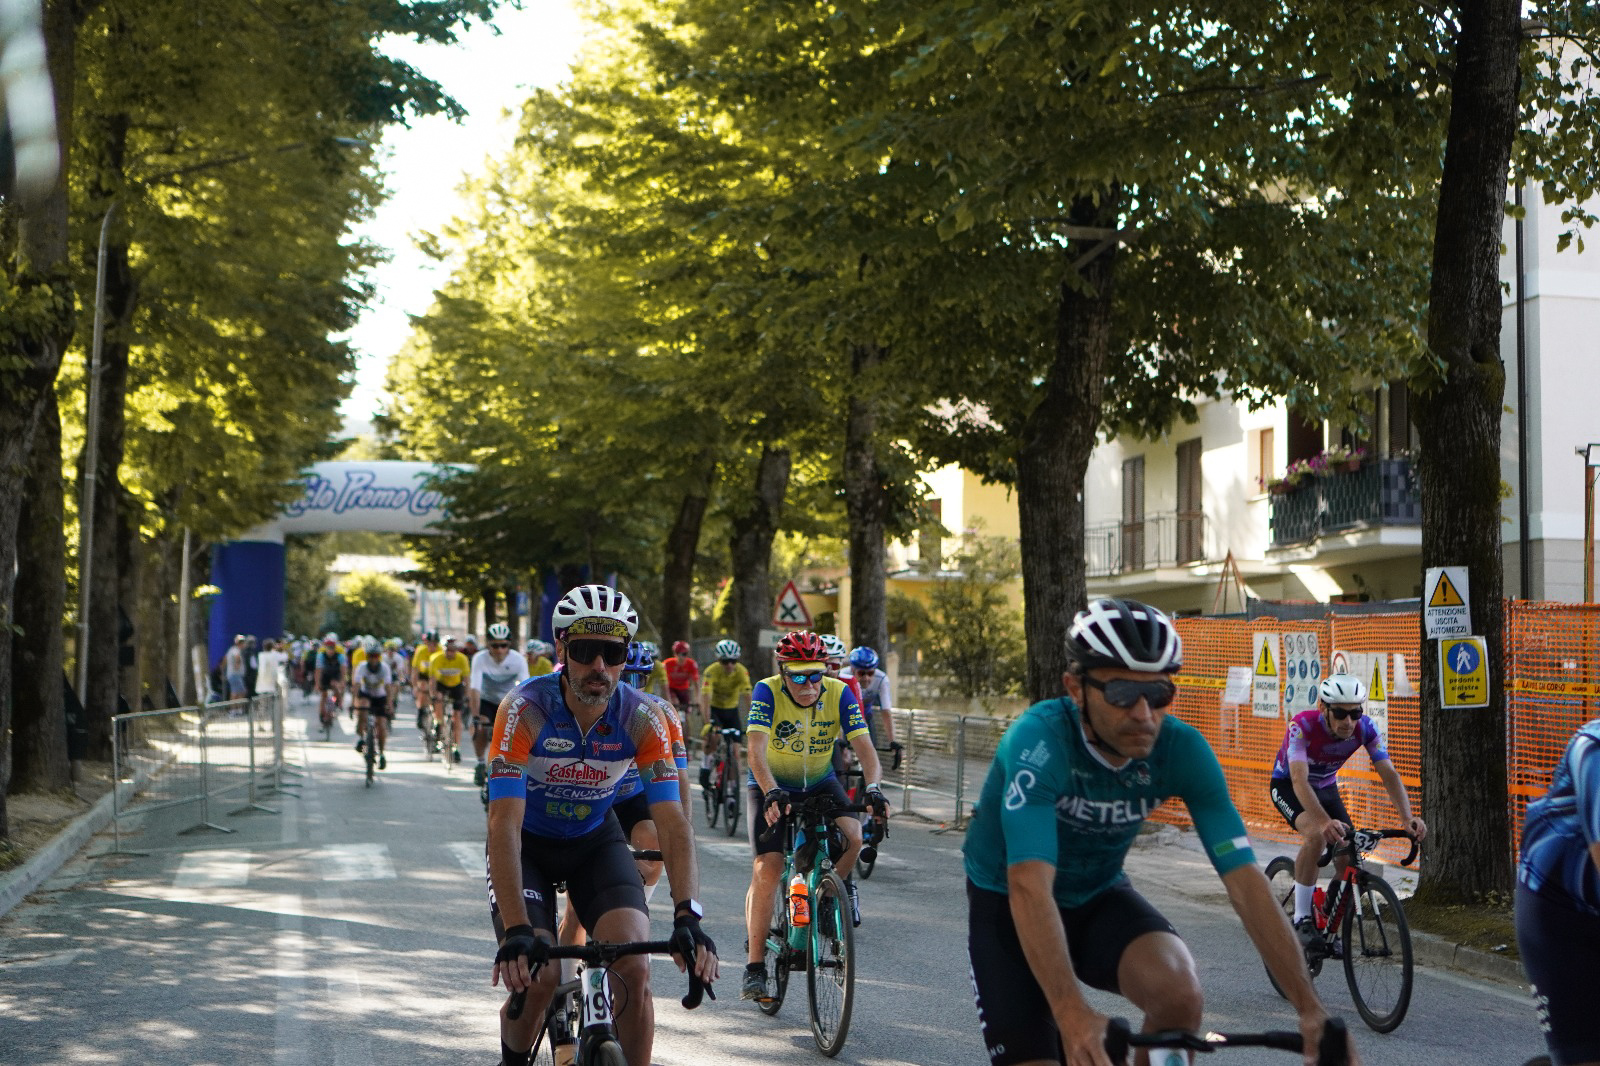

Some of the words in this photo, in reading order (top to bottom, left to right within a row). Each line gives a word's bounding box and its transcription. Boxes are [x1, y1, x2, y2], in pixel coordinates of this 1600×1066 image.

[333, 470, 411, 514] Promo
[1428, 607, 1467, 616] ATTENZIONE
[1435, 617, 1458, 625] USCITA
[1430, 625, 1467, 636] AUTOMEZZI
[811, 719, 835, 728] Gruppo
[808, 744, 832, 755] Frett
[549, 763, 608, 781] Castellani
[585, 991, 608, 1022] 19
